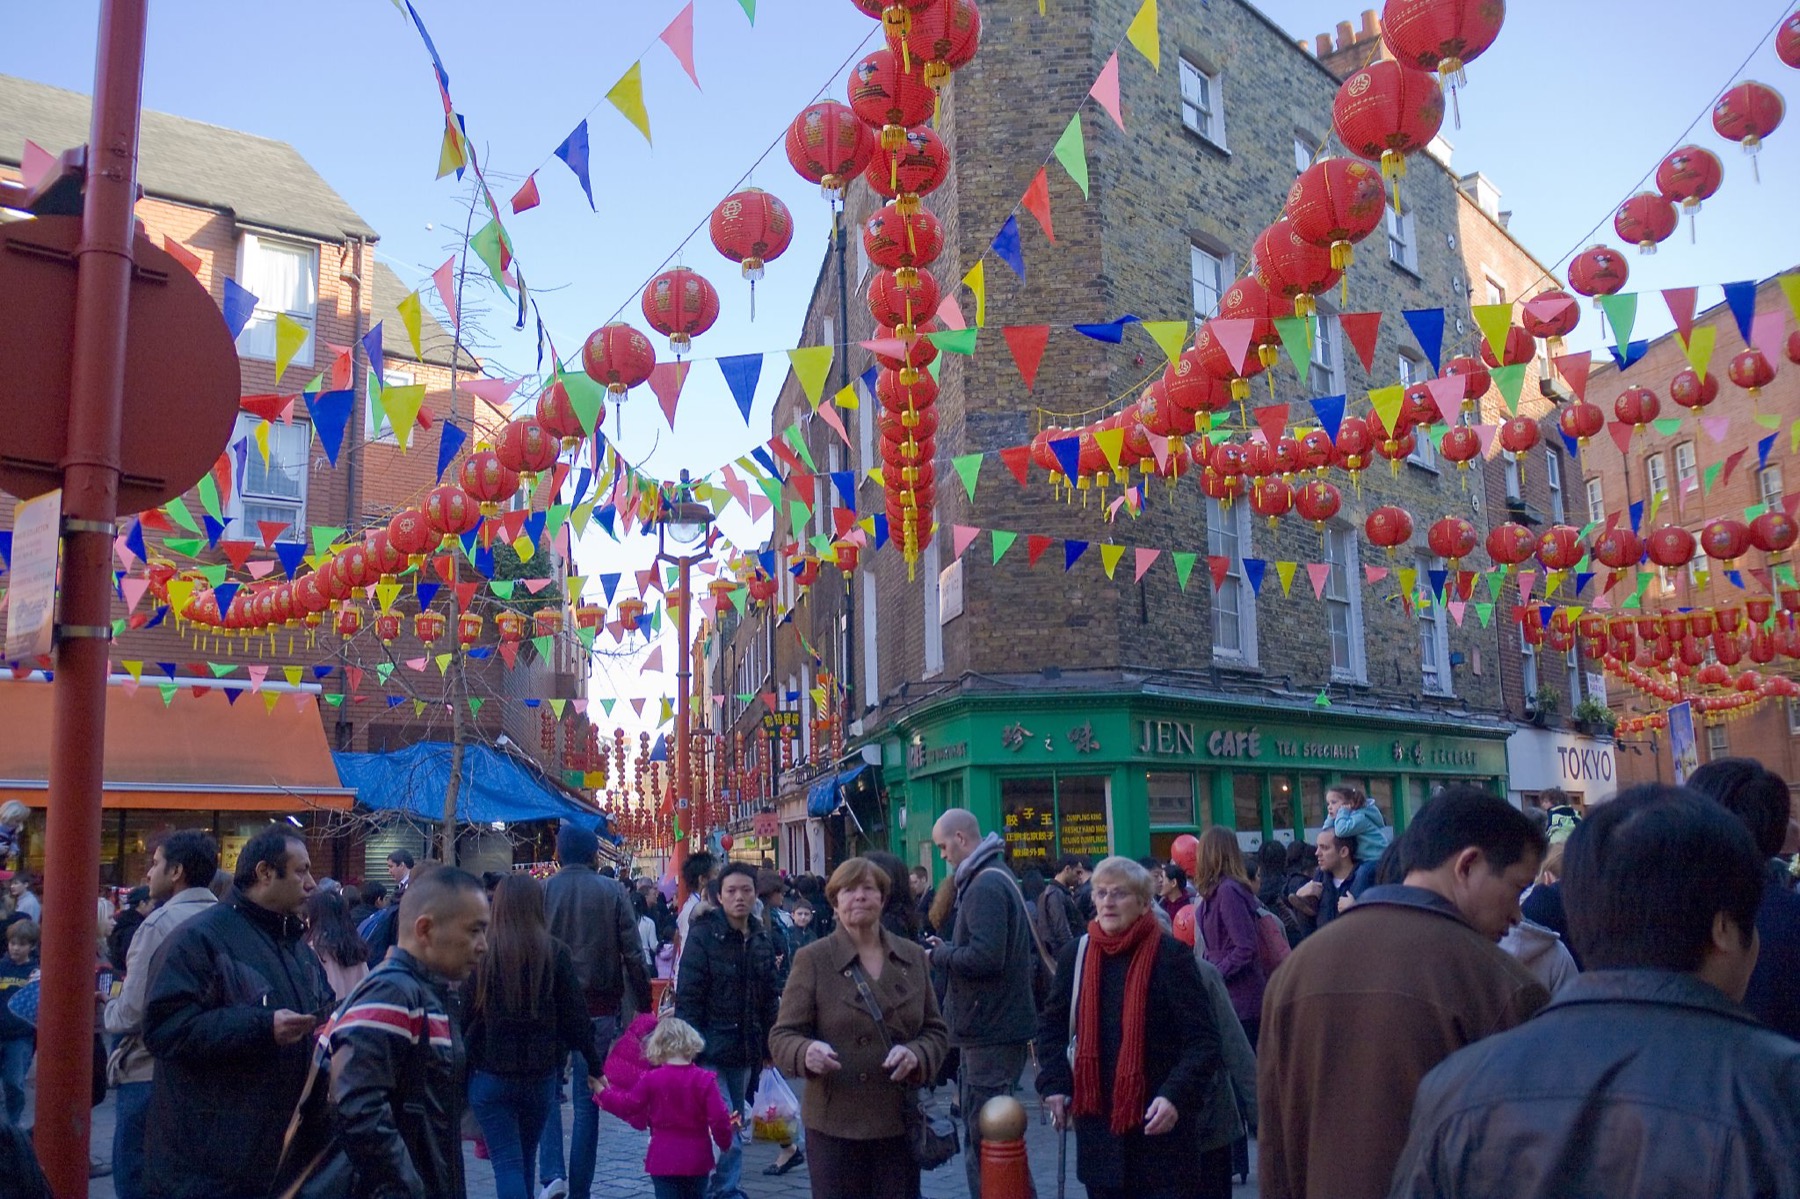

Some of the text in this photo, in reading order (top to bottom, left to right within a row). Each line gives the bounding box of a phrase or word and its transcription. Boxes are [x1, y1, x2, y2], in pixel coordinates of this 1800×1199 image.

[1139, 719, 1360, 759] JEN CAFÉ TEA SPECIALIST
[1557, 746, 1612, 782] TOKYO
